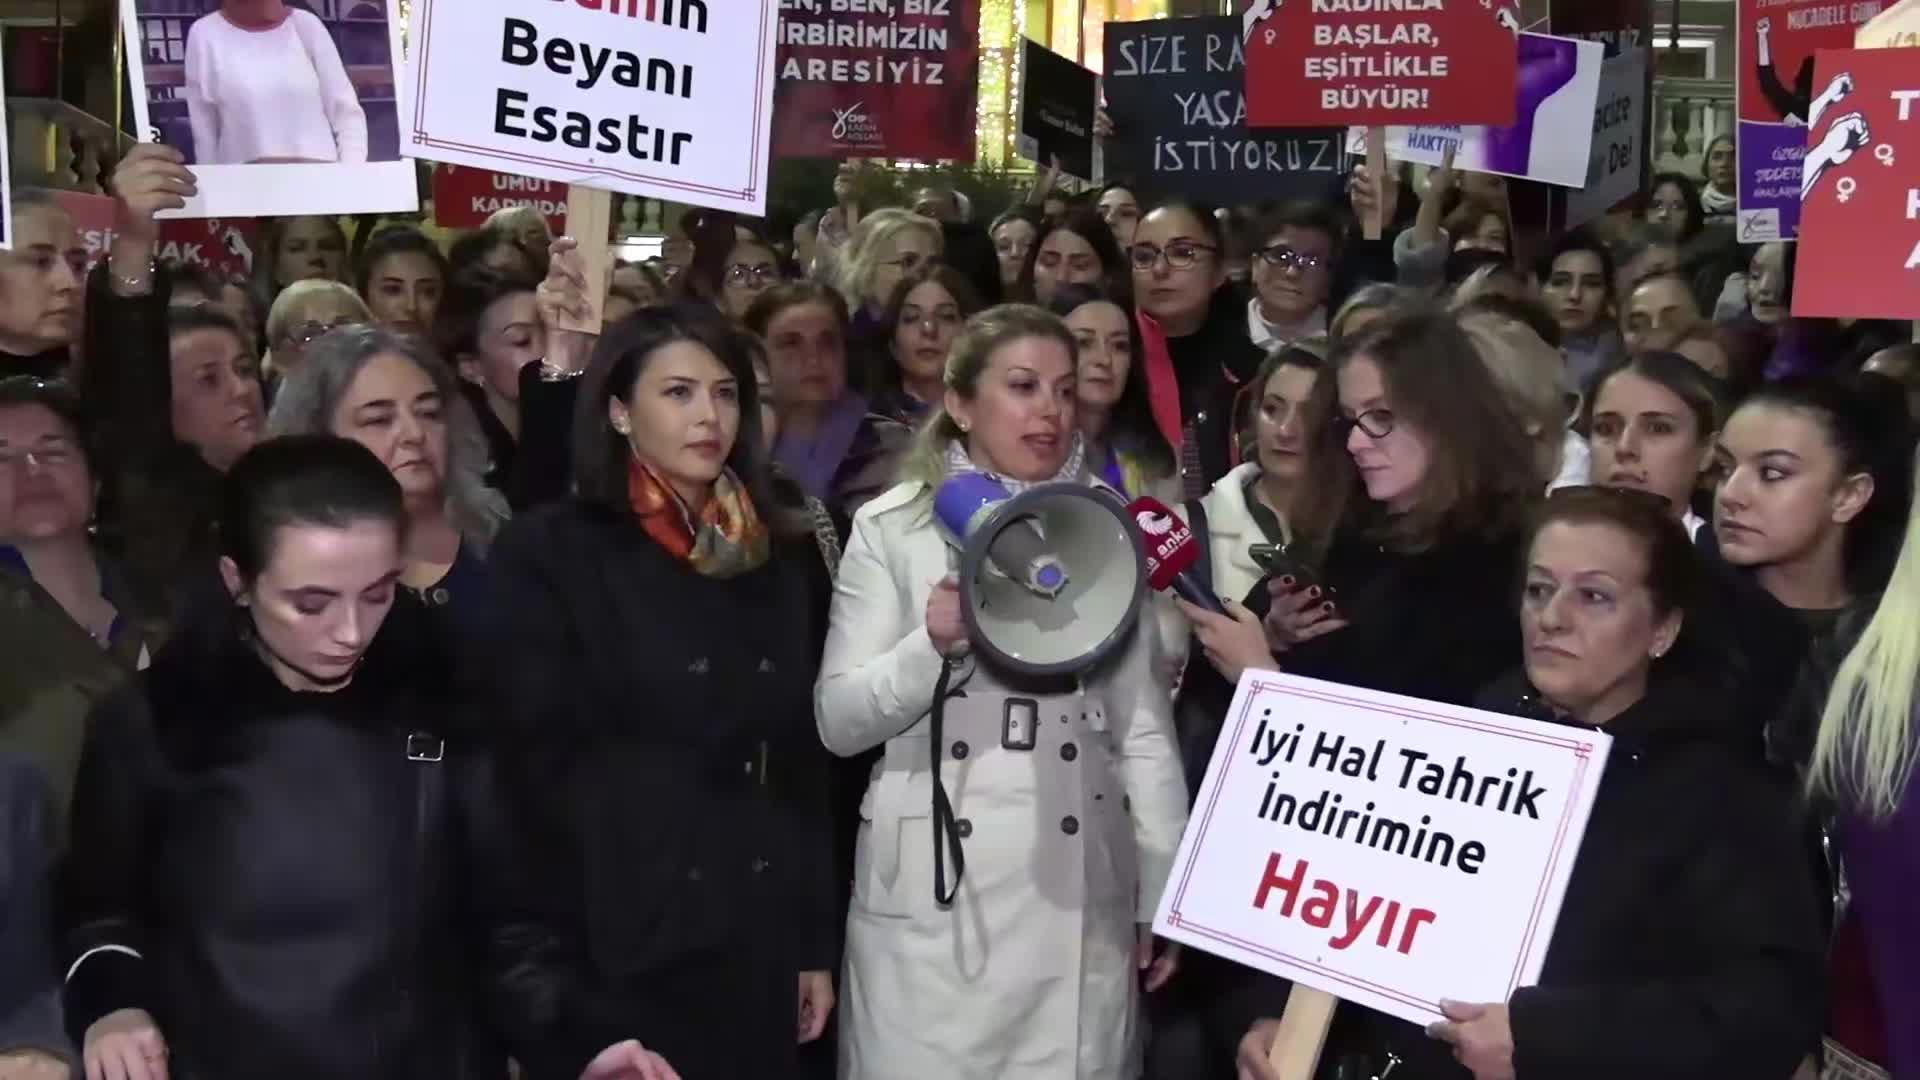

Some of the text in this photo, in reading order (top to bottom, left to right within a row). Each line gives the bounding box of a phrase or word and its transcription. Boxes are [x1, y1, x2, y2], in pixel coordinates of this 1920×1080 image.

[778, 17, 948, 50] İRBİRİMİZİN
[1314, 23, 1440, 48] BAŞLAR,
[501, 17, 693, 99] Beyanı
[781, 56, 944, 84] ARESİYİZ
[1113, 34, 1187, 76] SİZE
[1304, 52, 1448, 80] EŞİTLİKLE
[1173, 90, 1246, 130] YAŞA
[1321, 84, 1430, 109] BÜYÜR!
[494, 88, 693, 165] Esastır
[1157, 527, 1190, 556] anka
[1250, 709, 1546, 820] İyi Hal Tahrik
[1258, 772, 1486, 875] İndirimine
[1252, 852, 1436, 955] Hayır
